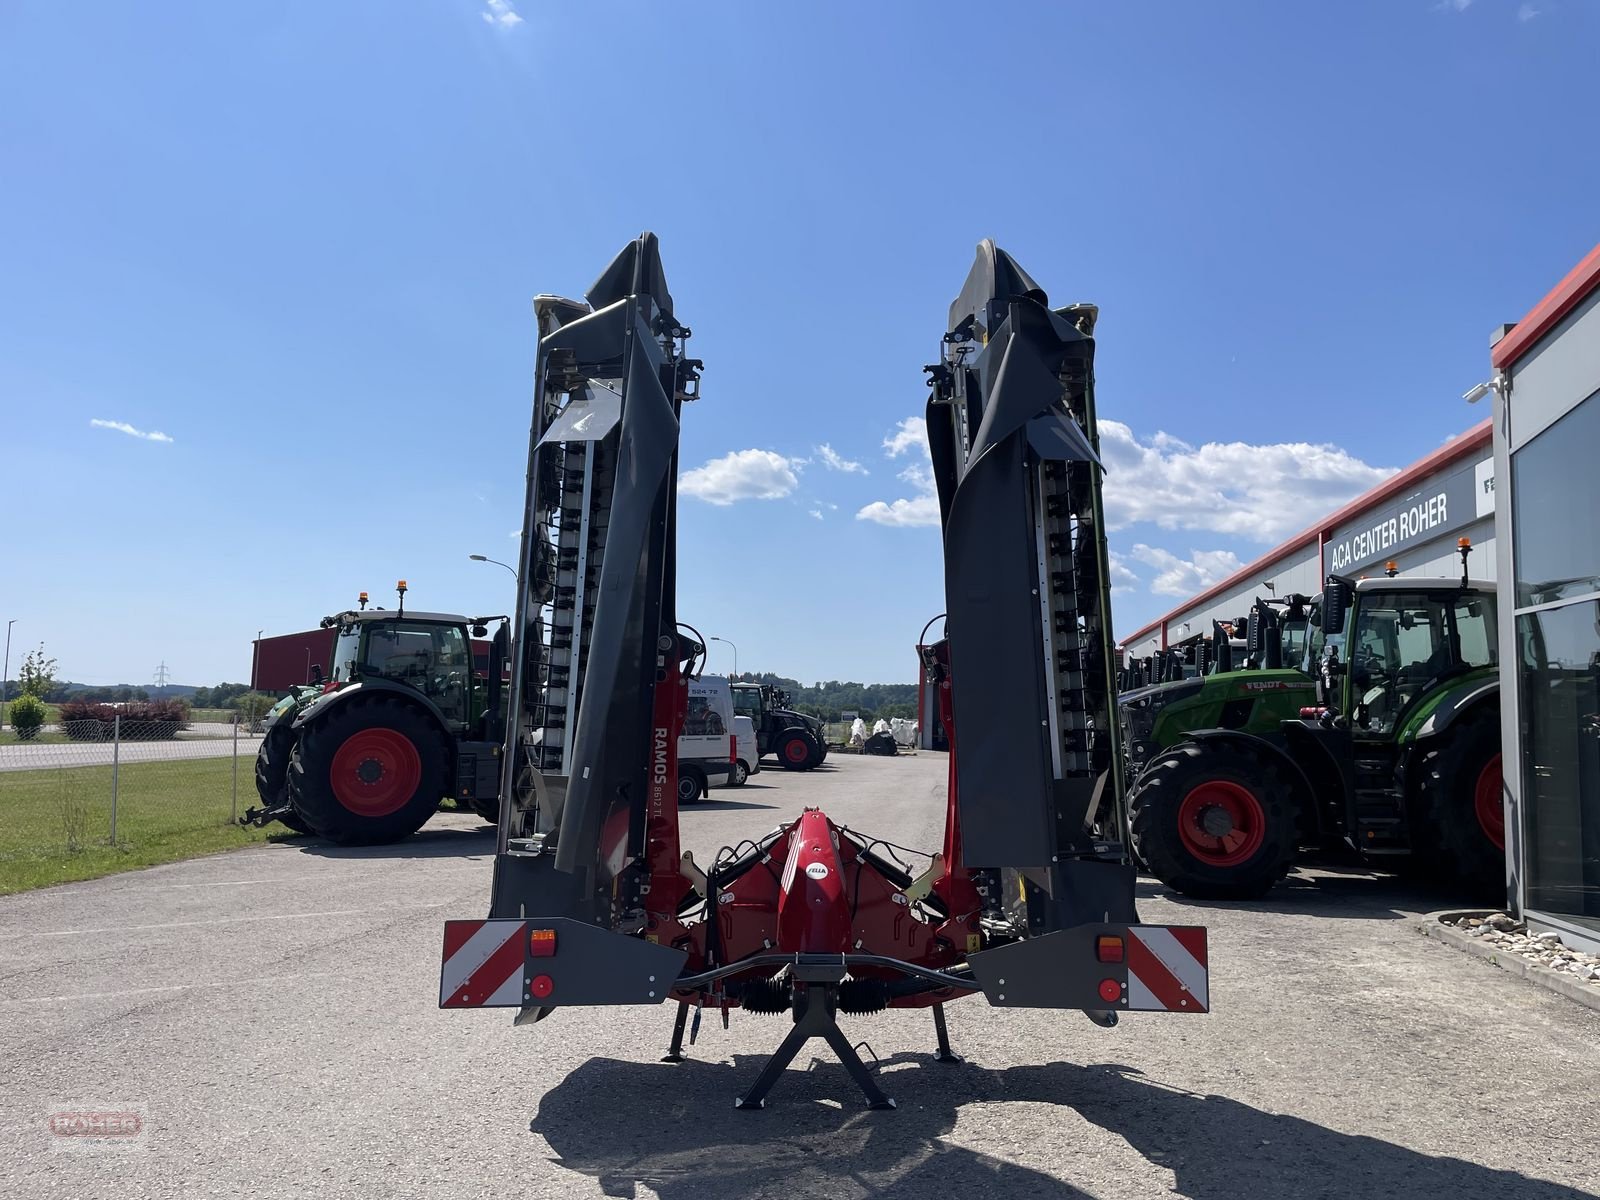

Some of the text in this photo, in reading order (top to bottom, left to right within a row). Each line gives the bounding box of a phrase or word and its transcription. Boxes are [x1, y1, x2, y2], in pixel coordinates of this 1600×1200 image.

[1331, 493, 1447, 572] ACA CENTER ROHER
[1246, 681, 1281, 689] FENDT
[655, 728, 668, 784] RAMOS
